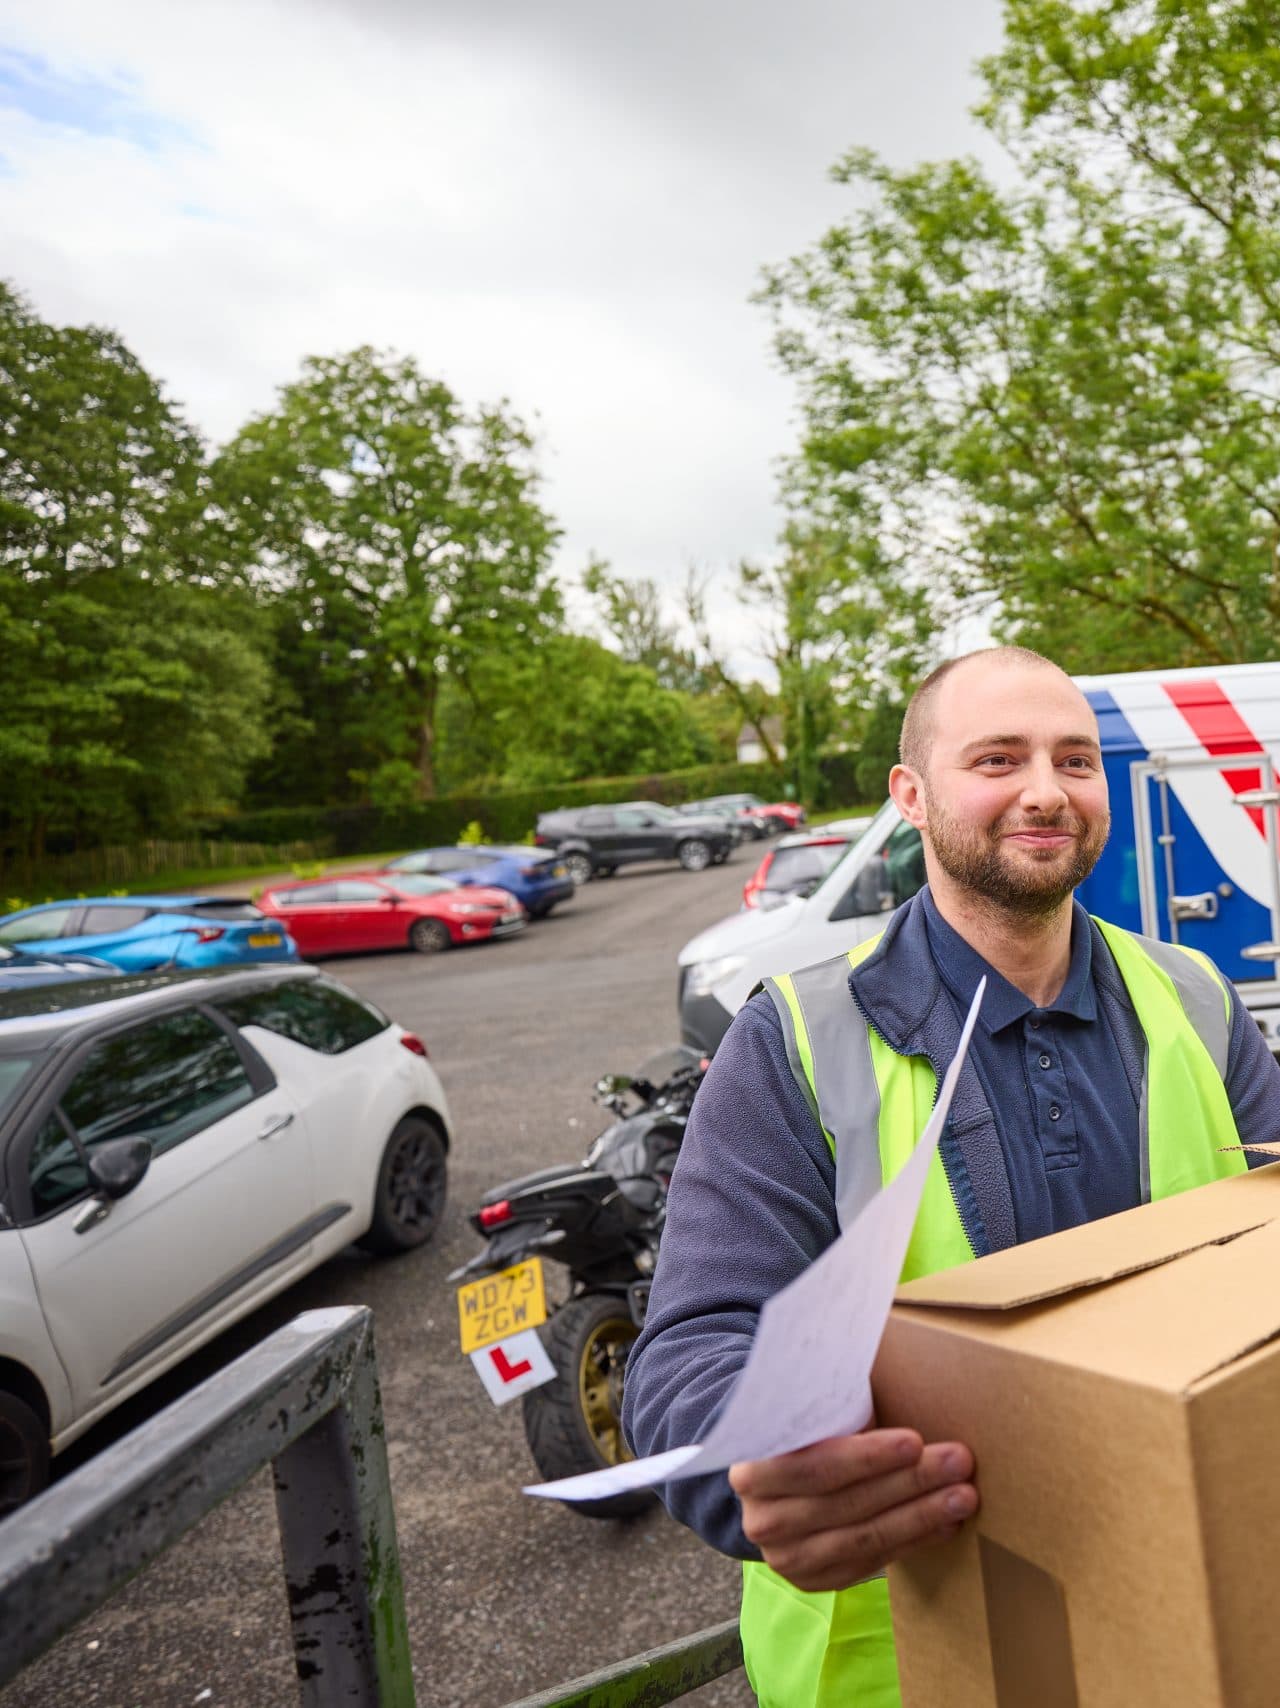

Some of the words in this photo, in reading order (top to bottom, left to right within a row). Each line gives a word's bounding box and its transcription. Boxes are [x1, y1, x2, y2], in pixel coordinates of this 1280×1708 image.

[463, 1267, 536, 1316] WD73
[475, 1300, 527, 1341] ZGW
[489, 1346, 533, 1384] L
